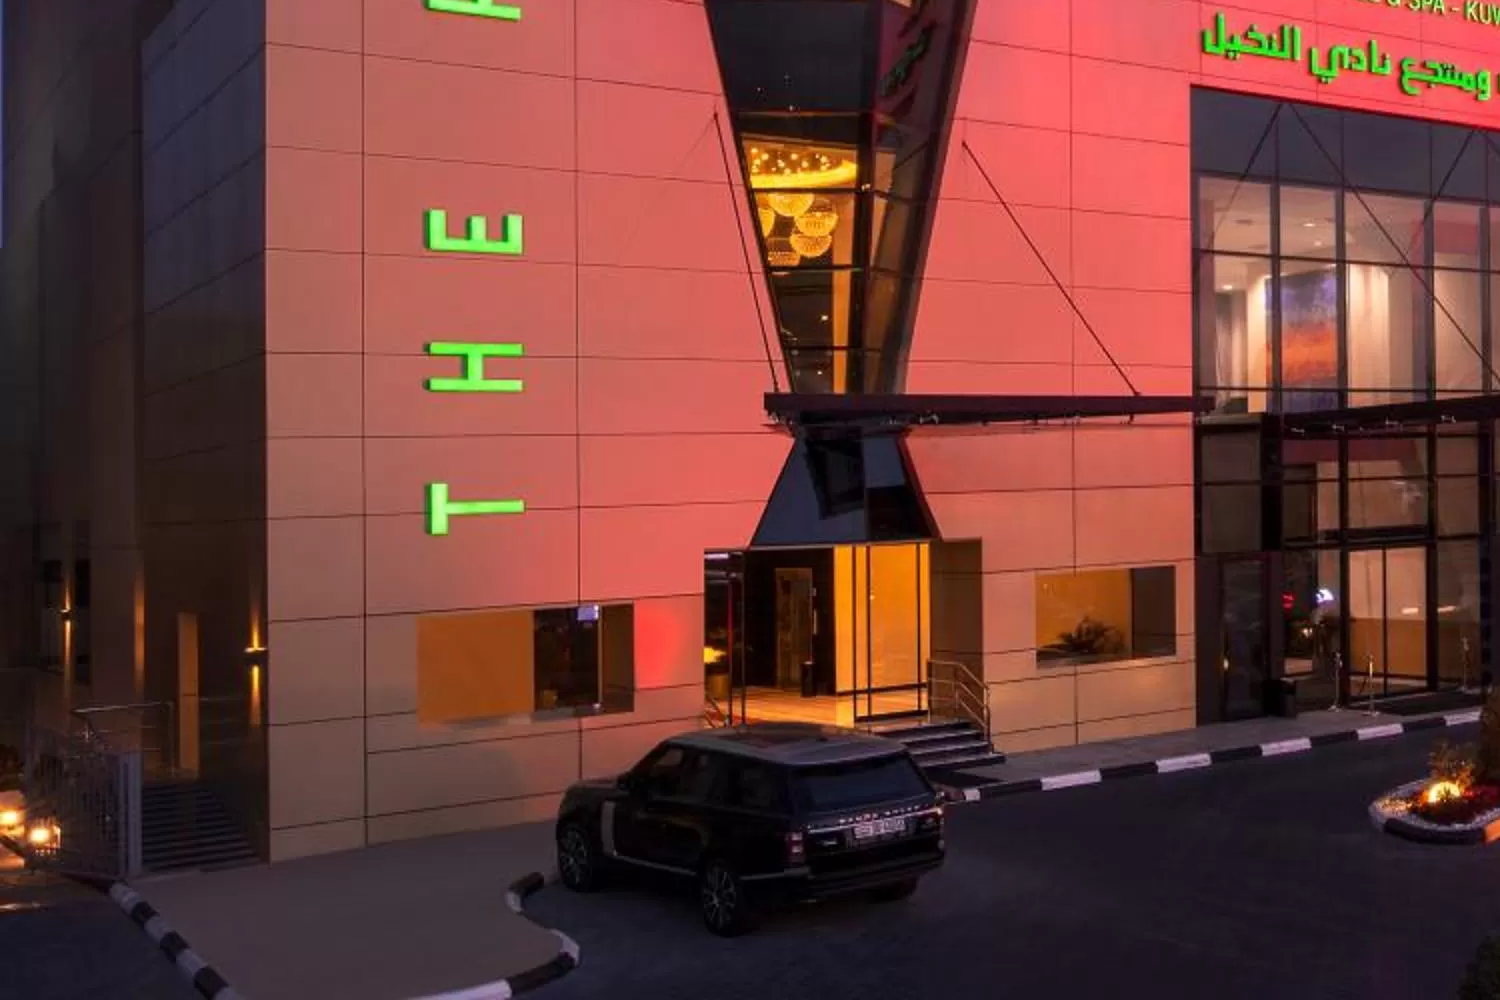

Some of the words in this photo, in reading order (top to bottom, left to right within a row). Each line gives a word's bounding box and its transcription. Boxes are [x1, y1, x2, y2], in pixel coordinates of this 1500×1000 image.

[1200, 12, 1301, 61] النخيل
[1309, 38, 1392, 84] نادي
[1399, 56, 1491, 102] ومنتجع
[422, 209, 525, 537] THE
